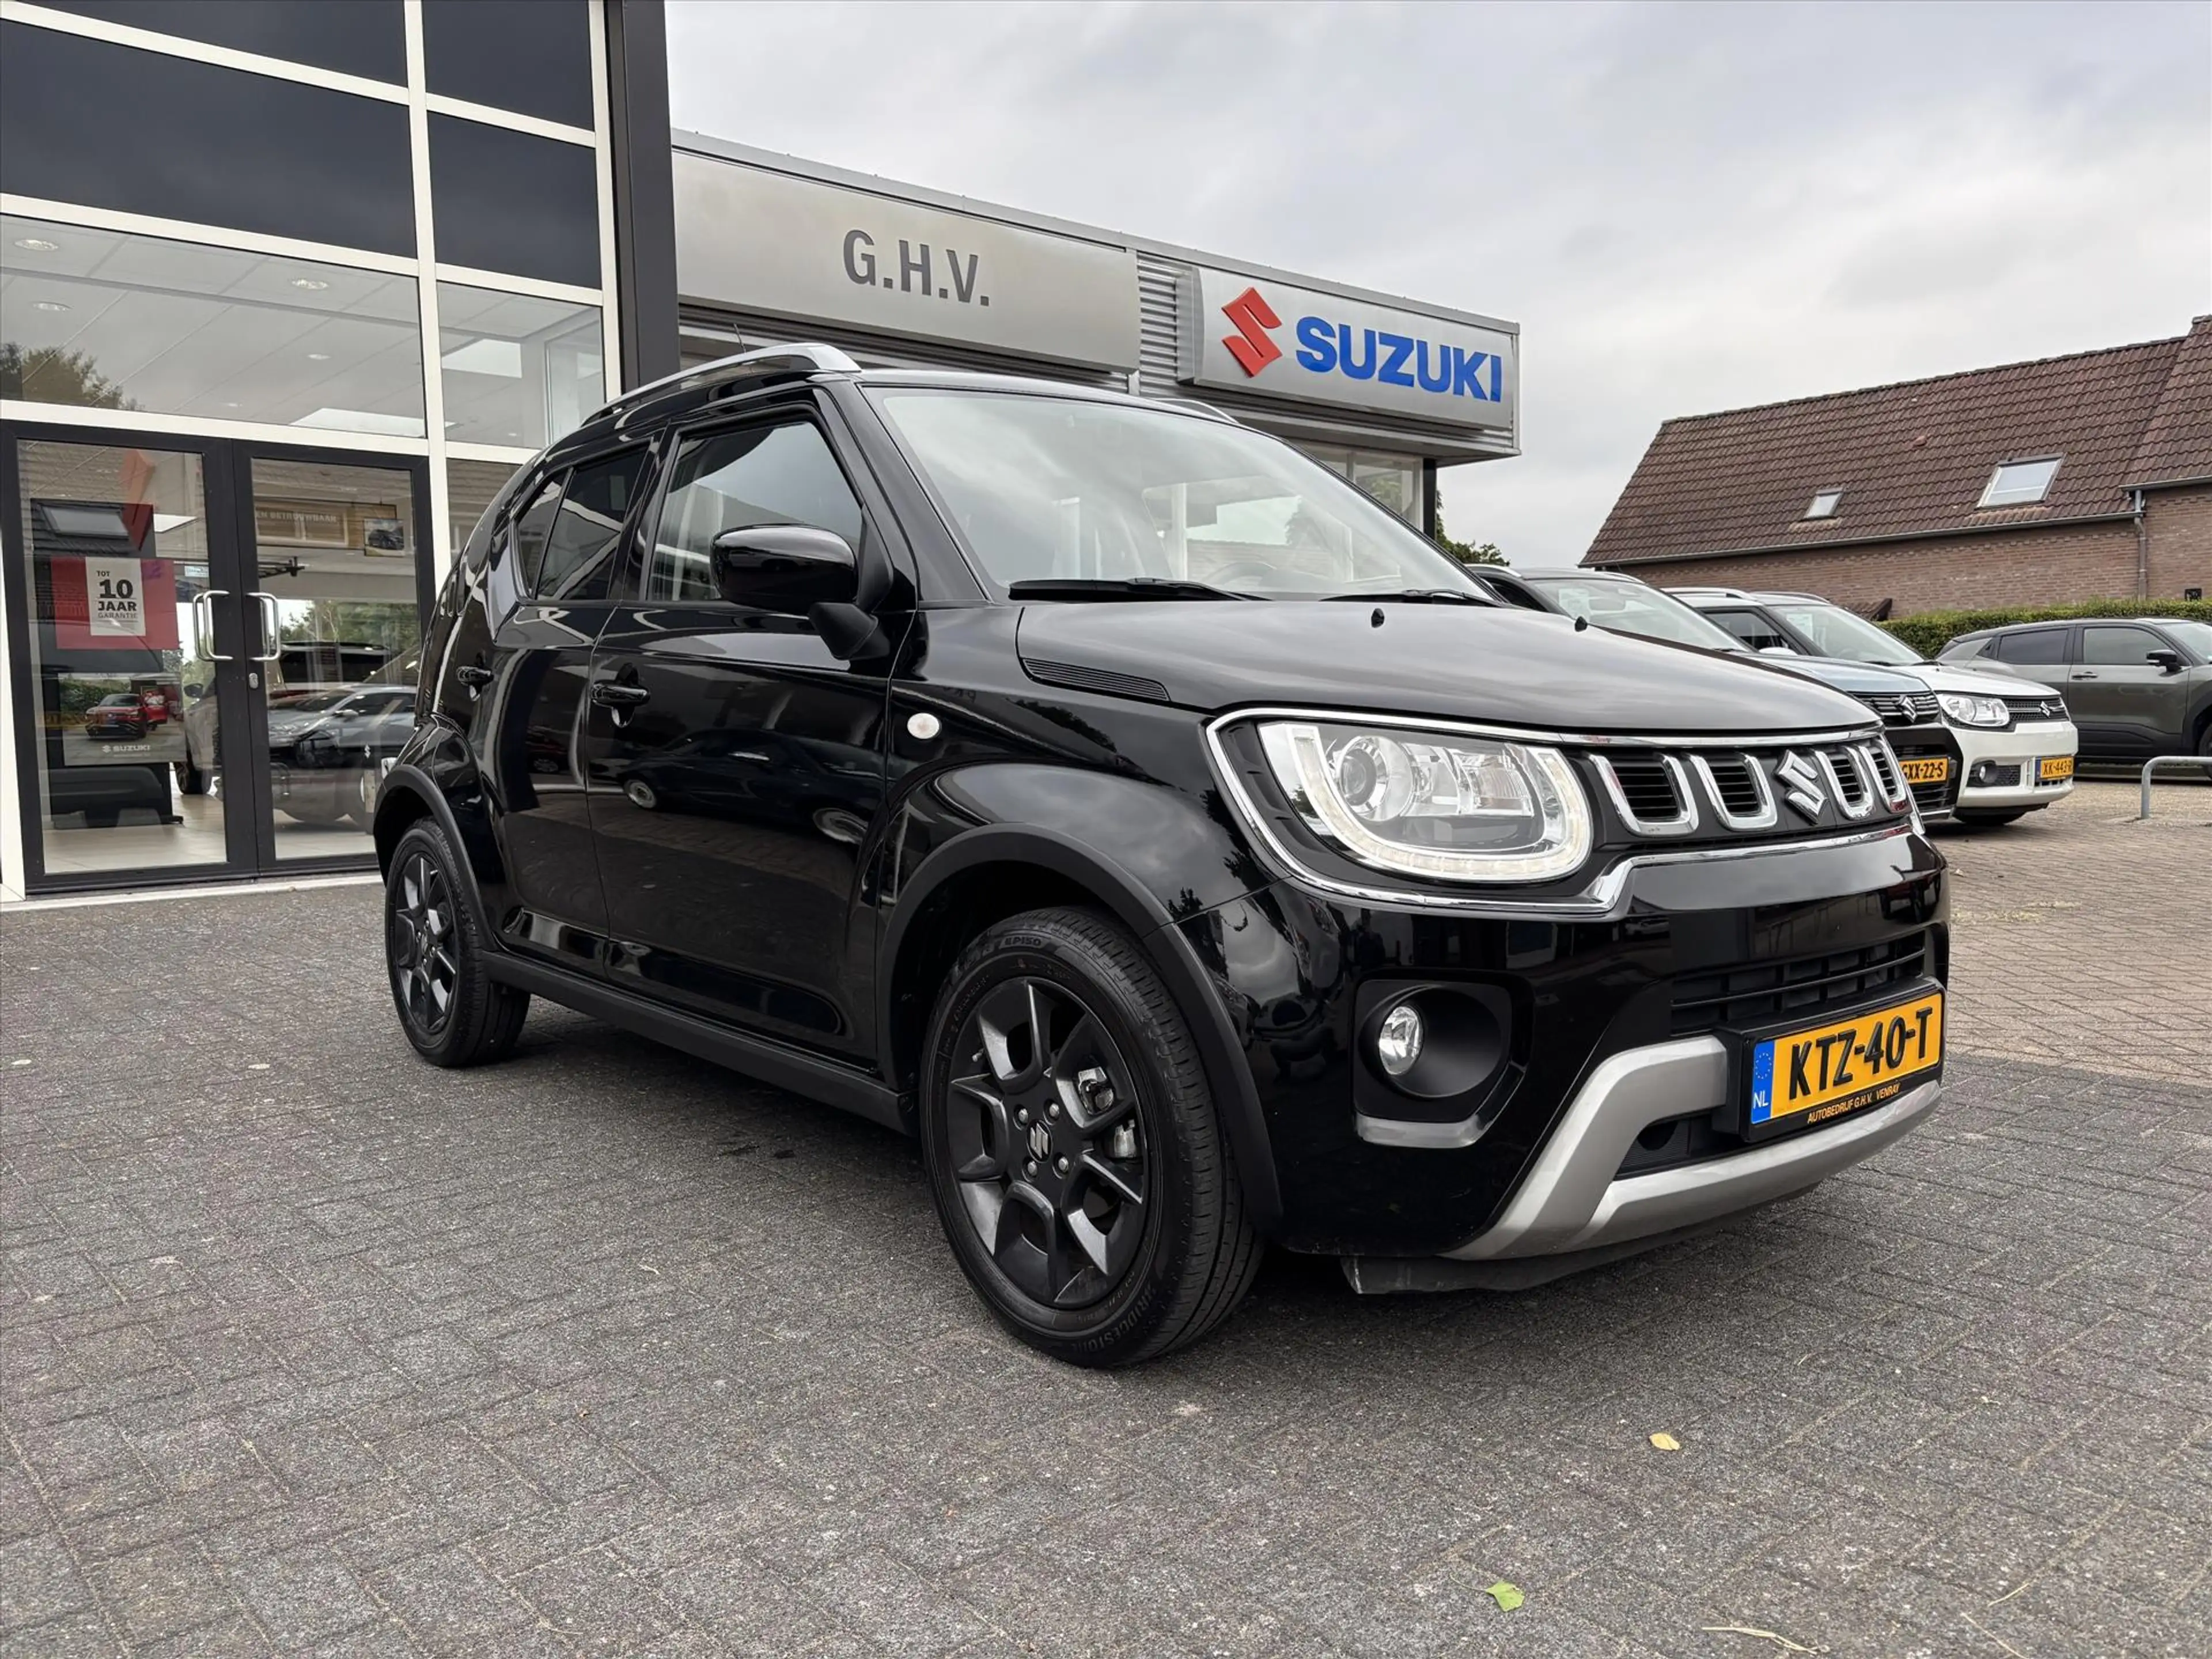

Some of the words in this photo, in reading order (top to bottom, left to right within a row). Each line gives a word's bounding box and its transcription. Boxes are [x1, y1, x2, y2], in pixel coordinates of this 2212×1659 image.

[843, 229, 990, 306] G.H.V.
[1296, 316, 1502, 403] SUZUKI
[97, 601, 137, 611] JAAR
[99, 579, 133, 599] 10
[1789, 1006, 1933, 1100] KTZ-40-T
[1753, 1090, 1769, 1109] NL
[1806, 1100, 1853, 1124] AUTOBEDRIJF
[1876, 1081, 1902, 1101] VENRAY
